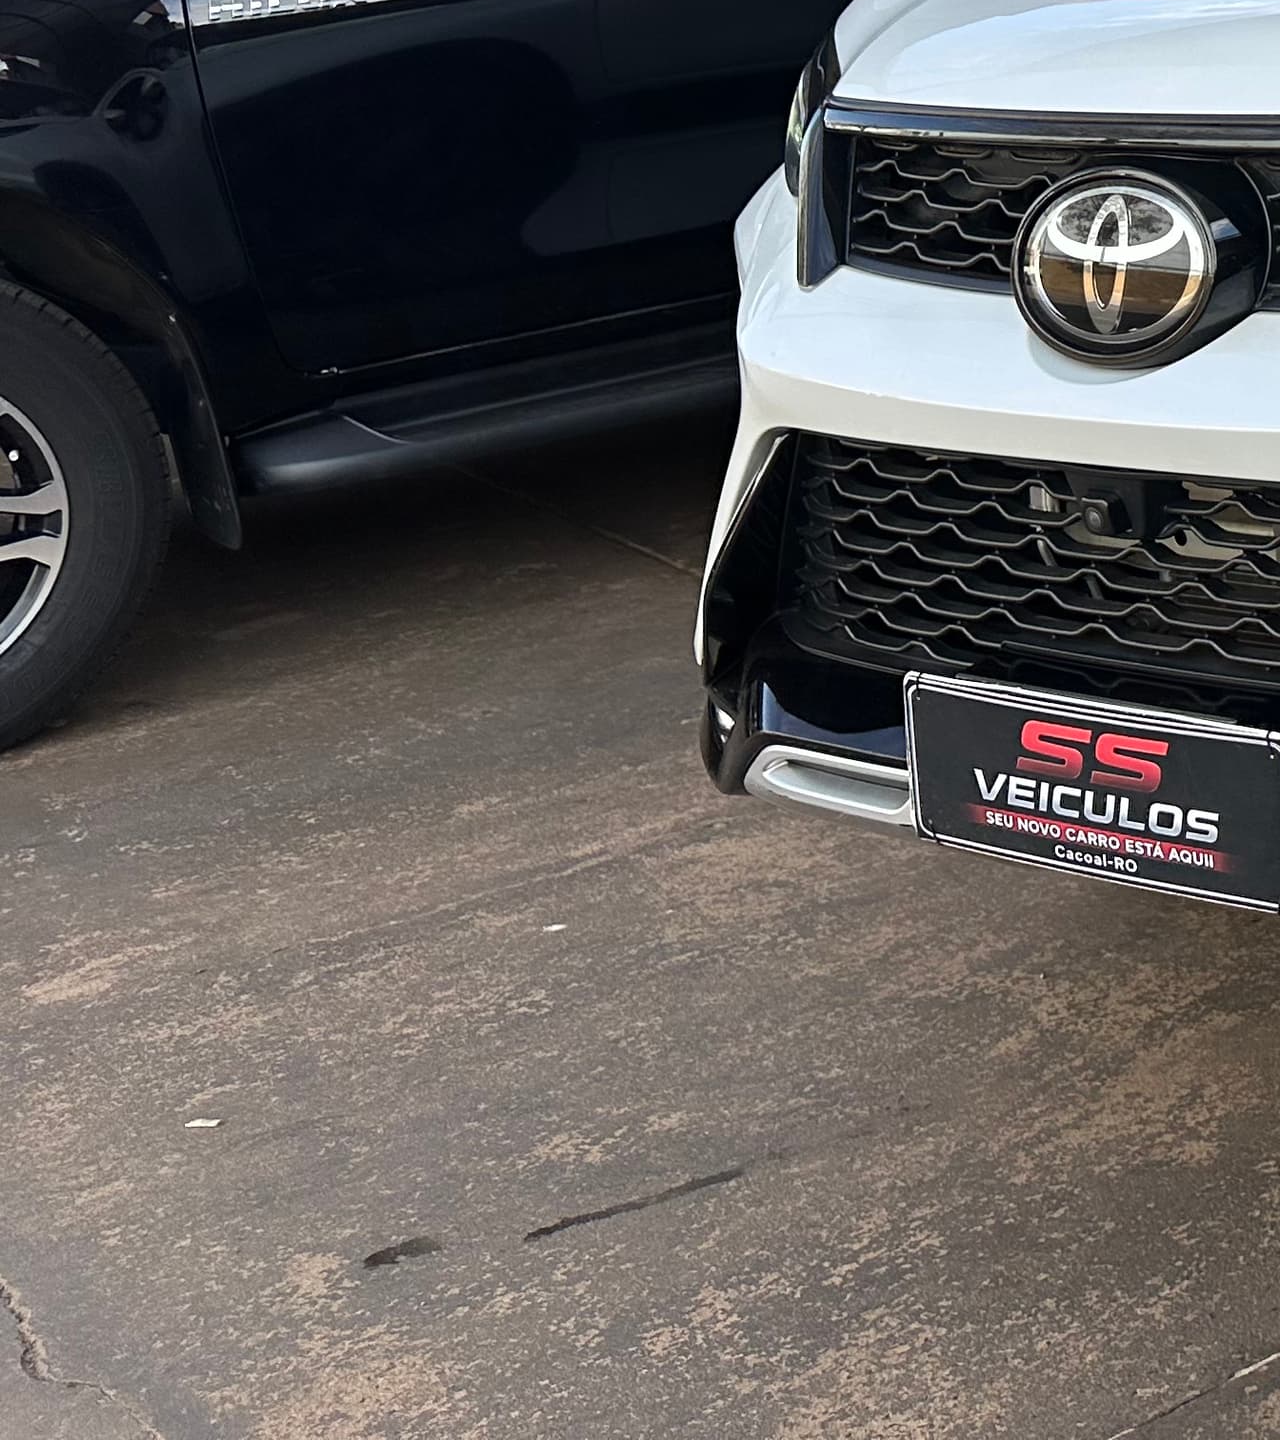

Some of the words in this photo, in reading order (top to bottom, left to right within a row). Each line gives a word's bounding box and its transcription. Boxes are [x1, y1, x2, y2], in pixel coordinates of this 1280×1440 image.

[1015, 719, 1170, 793] SS
[973, 767, 1220, 843] VEICULOS
[986, 812, 1013, 829] SEU
[1018, 818, 1061, 839] NOVO
[1065, 827, 1121, 850] CARRO
[1125, 838, 1164, 859] ESTÁ
[1054, 844, 1138, 872] Cacoal-RO
